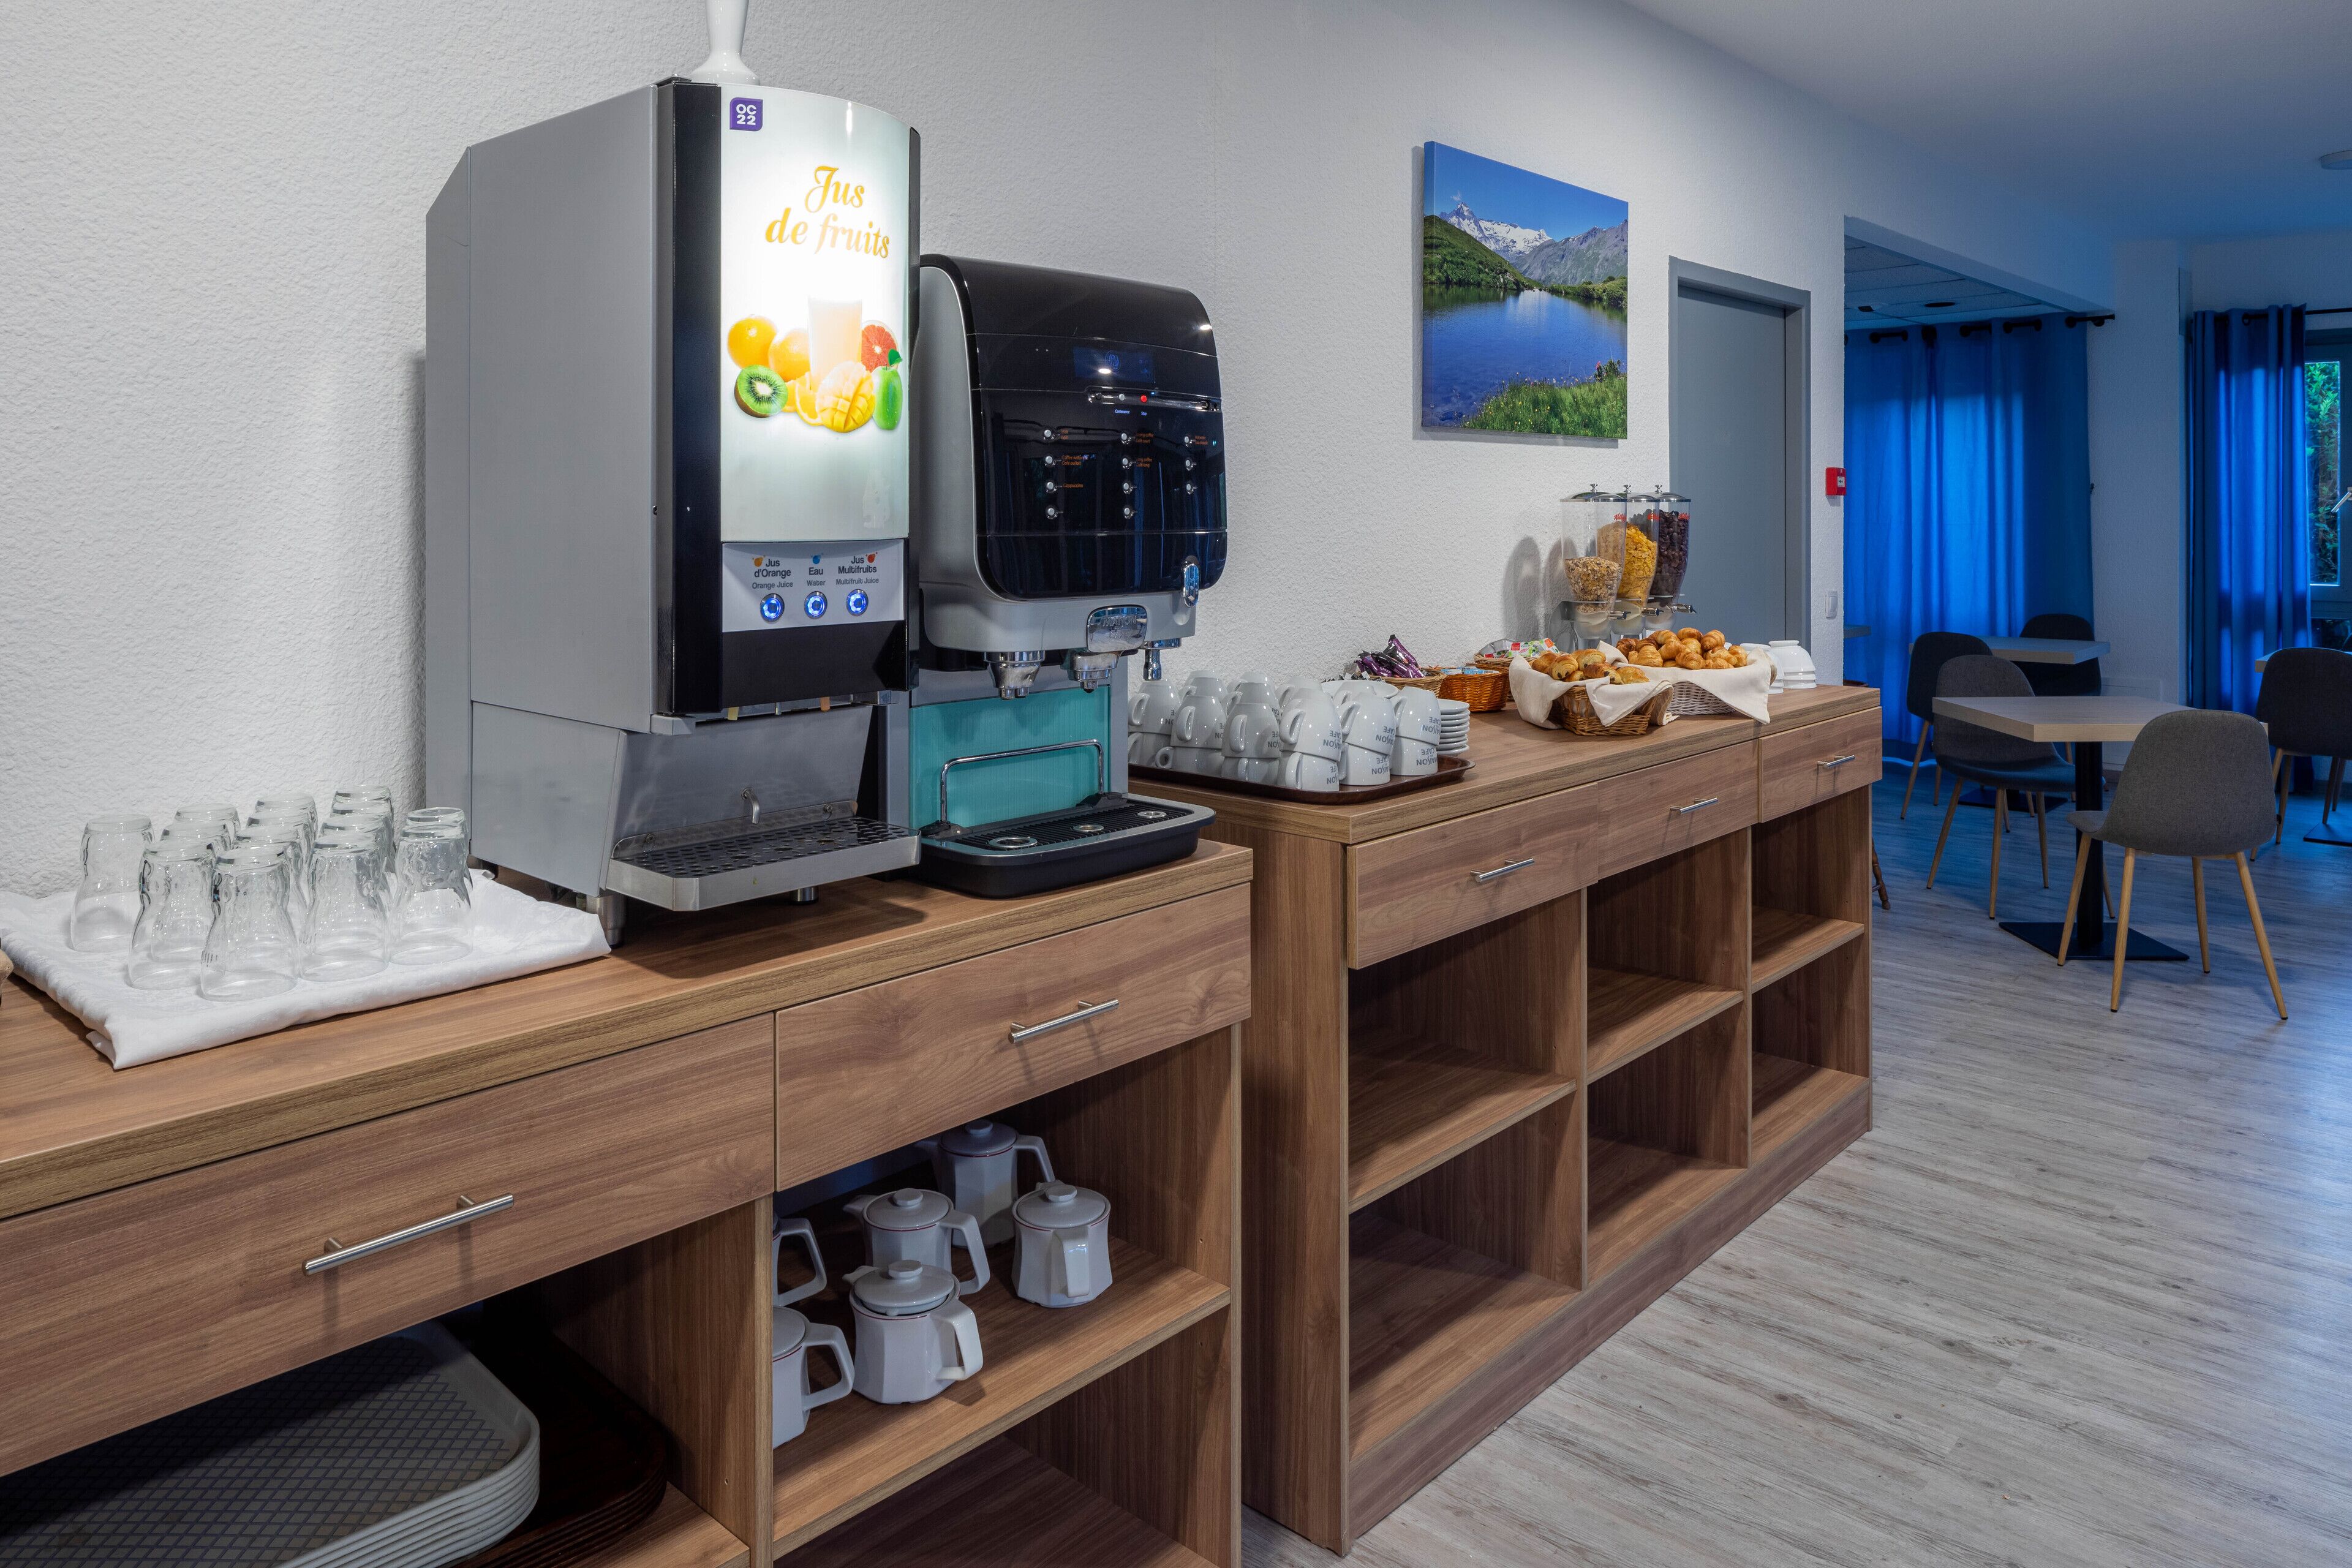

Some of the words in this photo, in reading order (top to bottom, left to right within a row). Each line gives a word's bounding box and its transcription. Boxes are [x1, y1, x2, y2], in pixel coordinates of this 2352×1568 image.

[736, 104, 756, 115] OC
[736, 114, 756, 126] 22
[805, 165, 865, 213] Jus
[765, 207, 809, 244] de
[814, 213, 890, 258] fruits
[766, 559, 780, 567] Jus
[851, 556, 865, 564] Jus
[754, 568, 791, 579] d'Orange
[809, 567, 824, 575] Eau
[838, 565, 877, 574] Multifruits
